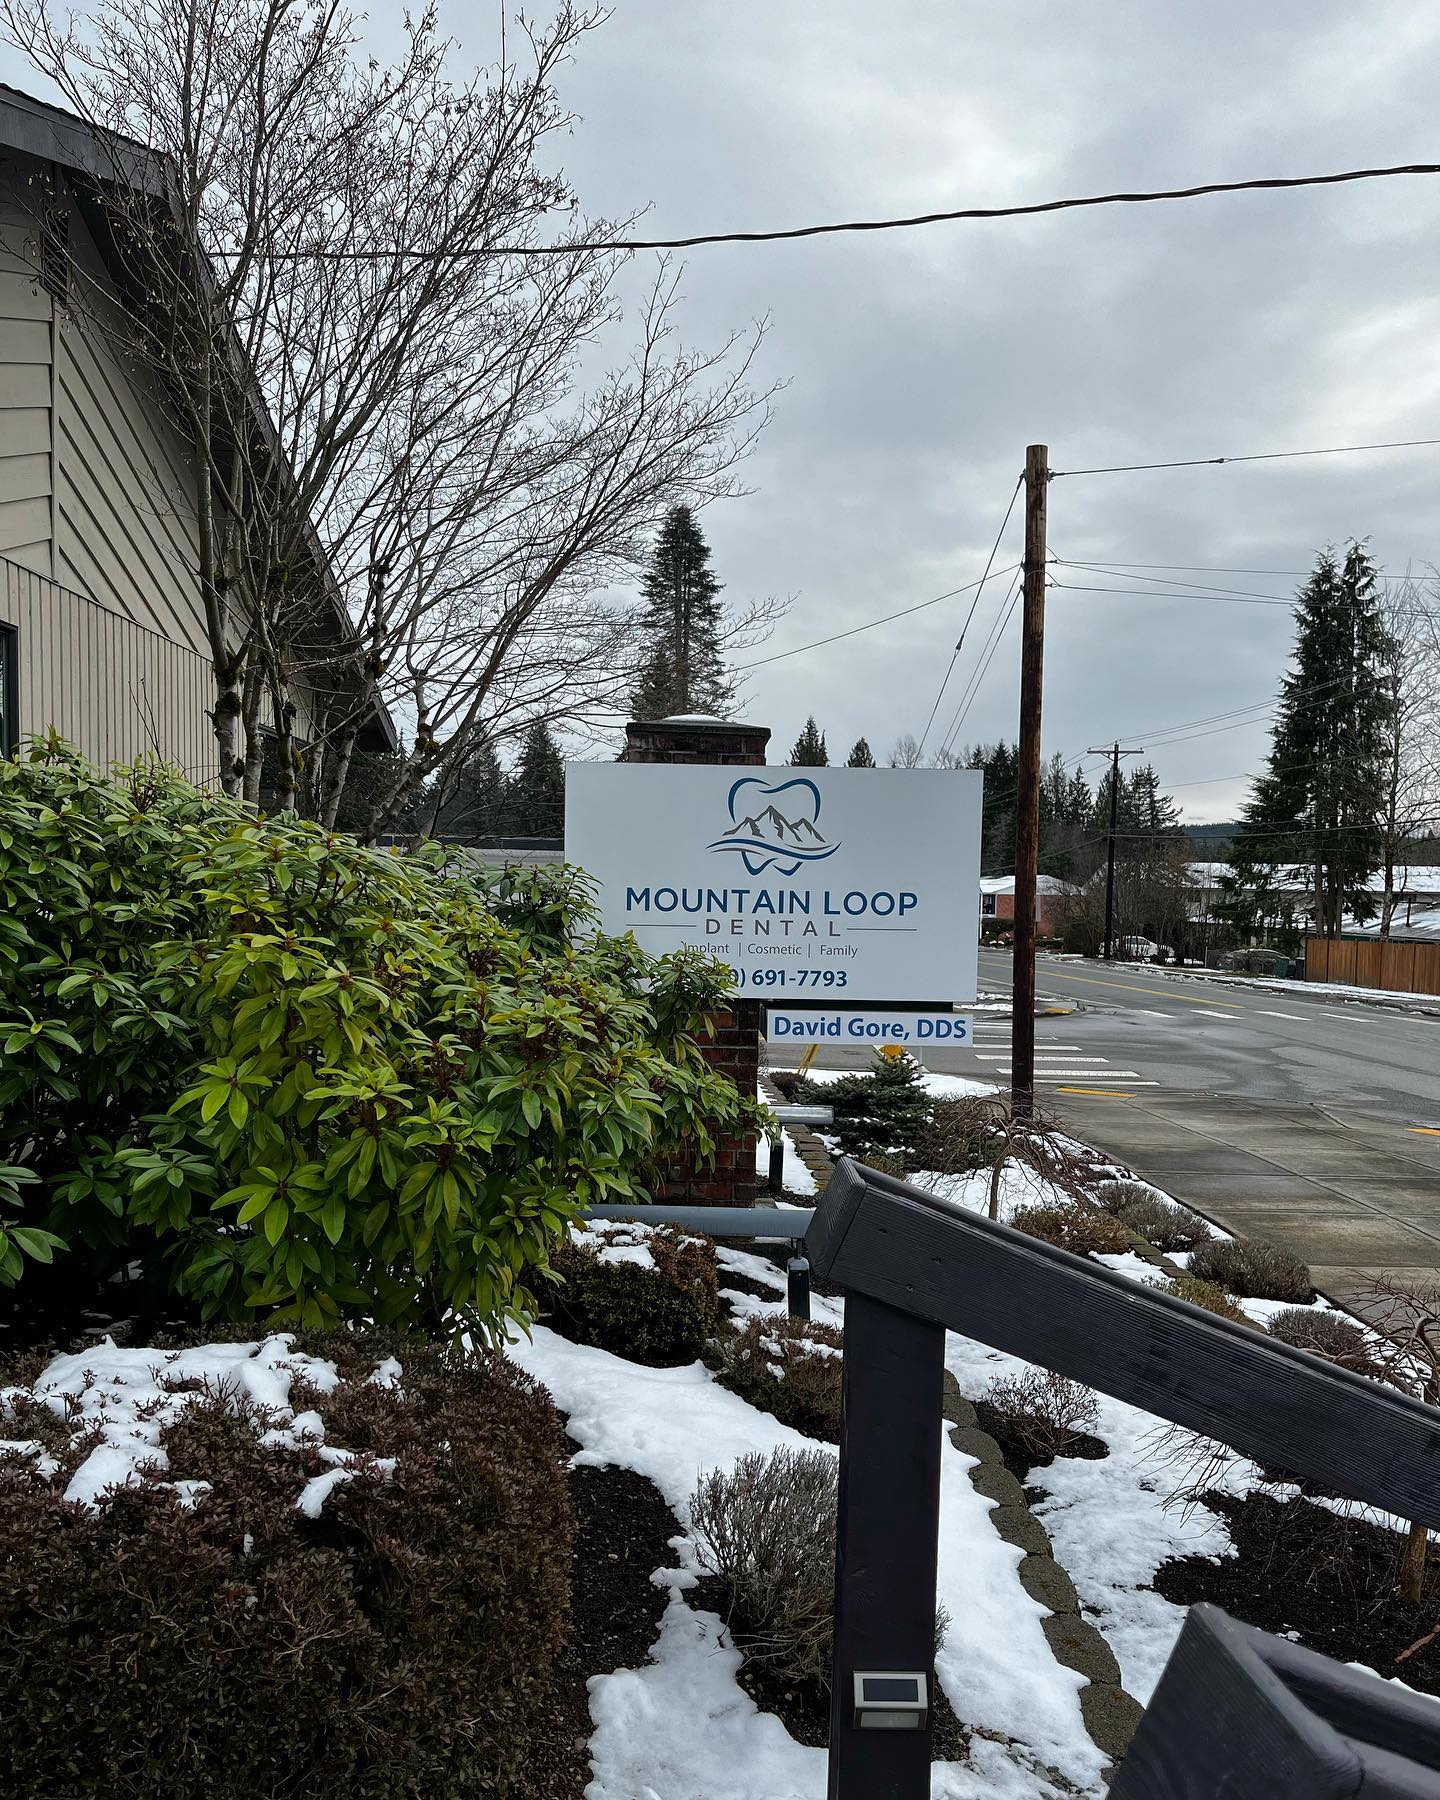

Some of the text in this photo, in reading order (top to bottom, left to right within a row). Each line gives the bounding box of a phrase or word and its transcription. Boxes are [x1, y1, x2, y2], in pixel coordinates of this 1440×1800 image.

[626, 887, 918, 916] MOUNTAIN LOOP
[705, 918, 841, 937] DENTAL
[685, 942, 858, 959] mplant Cosmetic Family
[751, 969, 848, 987] 691-7793
[774, 1016, 967, 1040] David Gore, DDS
